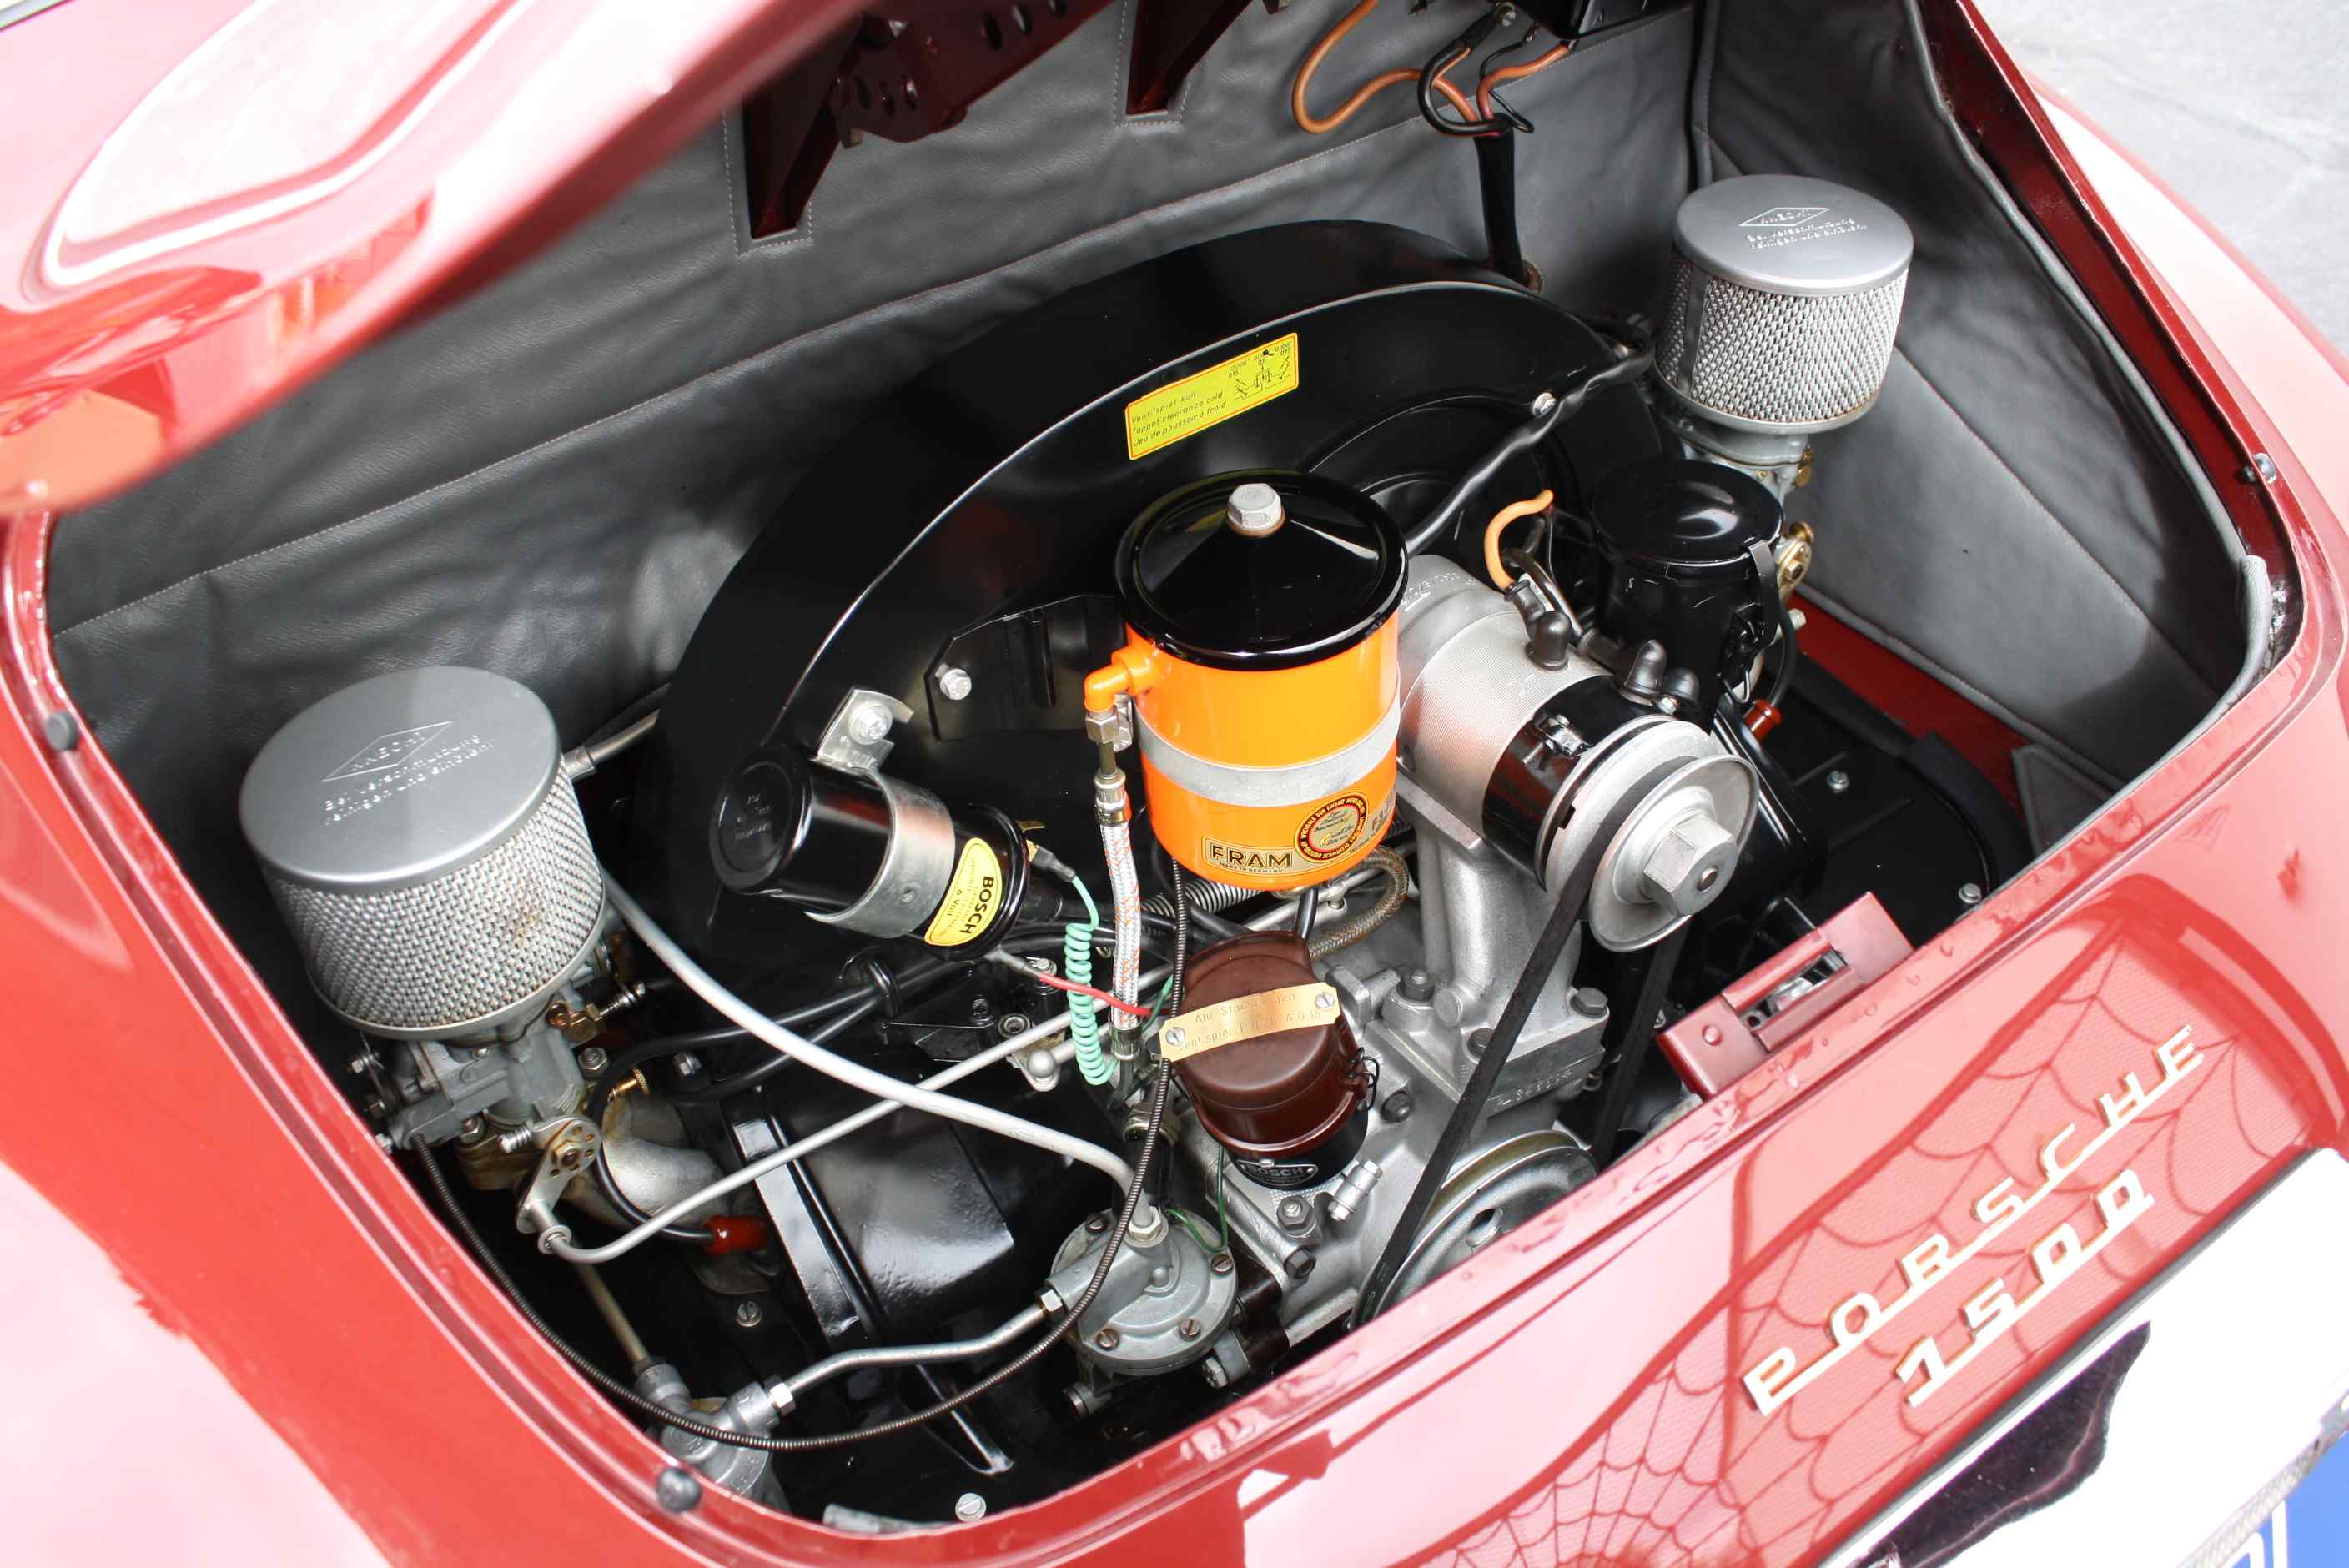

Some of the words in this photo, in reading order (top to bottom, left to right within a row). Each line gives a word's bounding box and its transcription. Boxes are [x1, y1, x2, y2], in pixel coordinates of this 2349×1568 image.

[1161, 400, 1204, 422] clearance
[1206, 391, 1224, 403] cold
[1207, 400, 1228, 415] froid
[1211, 843, 1291, 867] FRAM
[959, 876, 994, 934] BOSCH
[1743, 1024, 2205, 1416] PORSCHE
[1894, 1168, 2155, 1408] 1500
